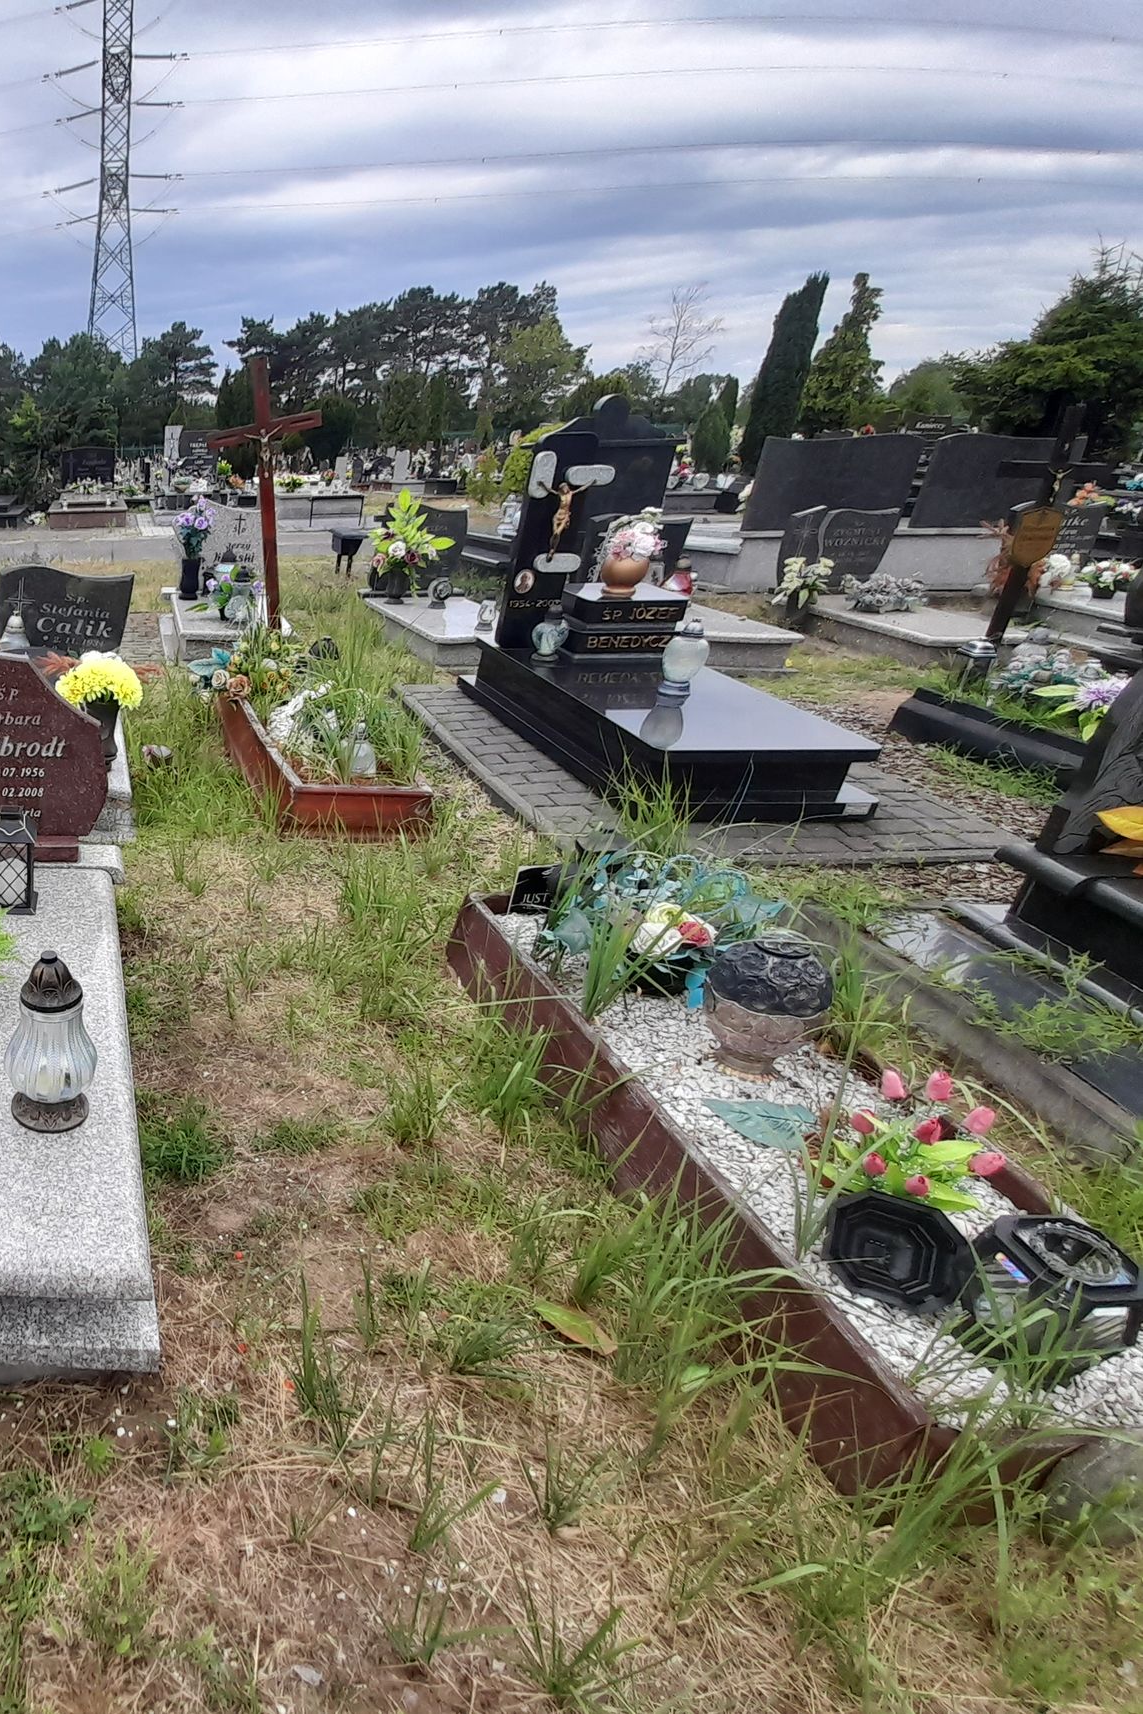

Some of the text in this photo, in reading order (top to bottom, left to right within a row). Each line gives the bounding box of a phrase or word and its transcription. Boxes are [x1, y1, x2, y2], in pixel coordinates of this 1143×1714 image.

[40, 603, 110, 619] Stefania
[628, 603, 679, 620] JÓZEF
[36, 617, 112, 638] Calik
[2, 787, 44, 797] 02.2008
